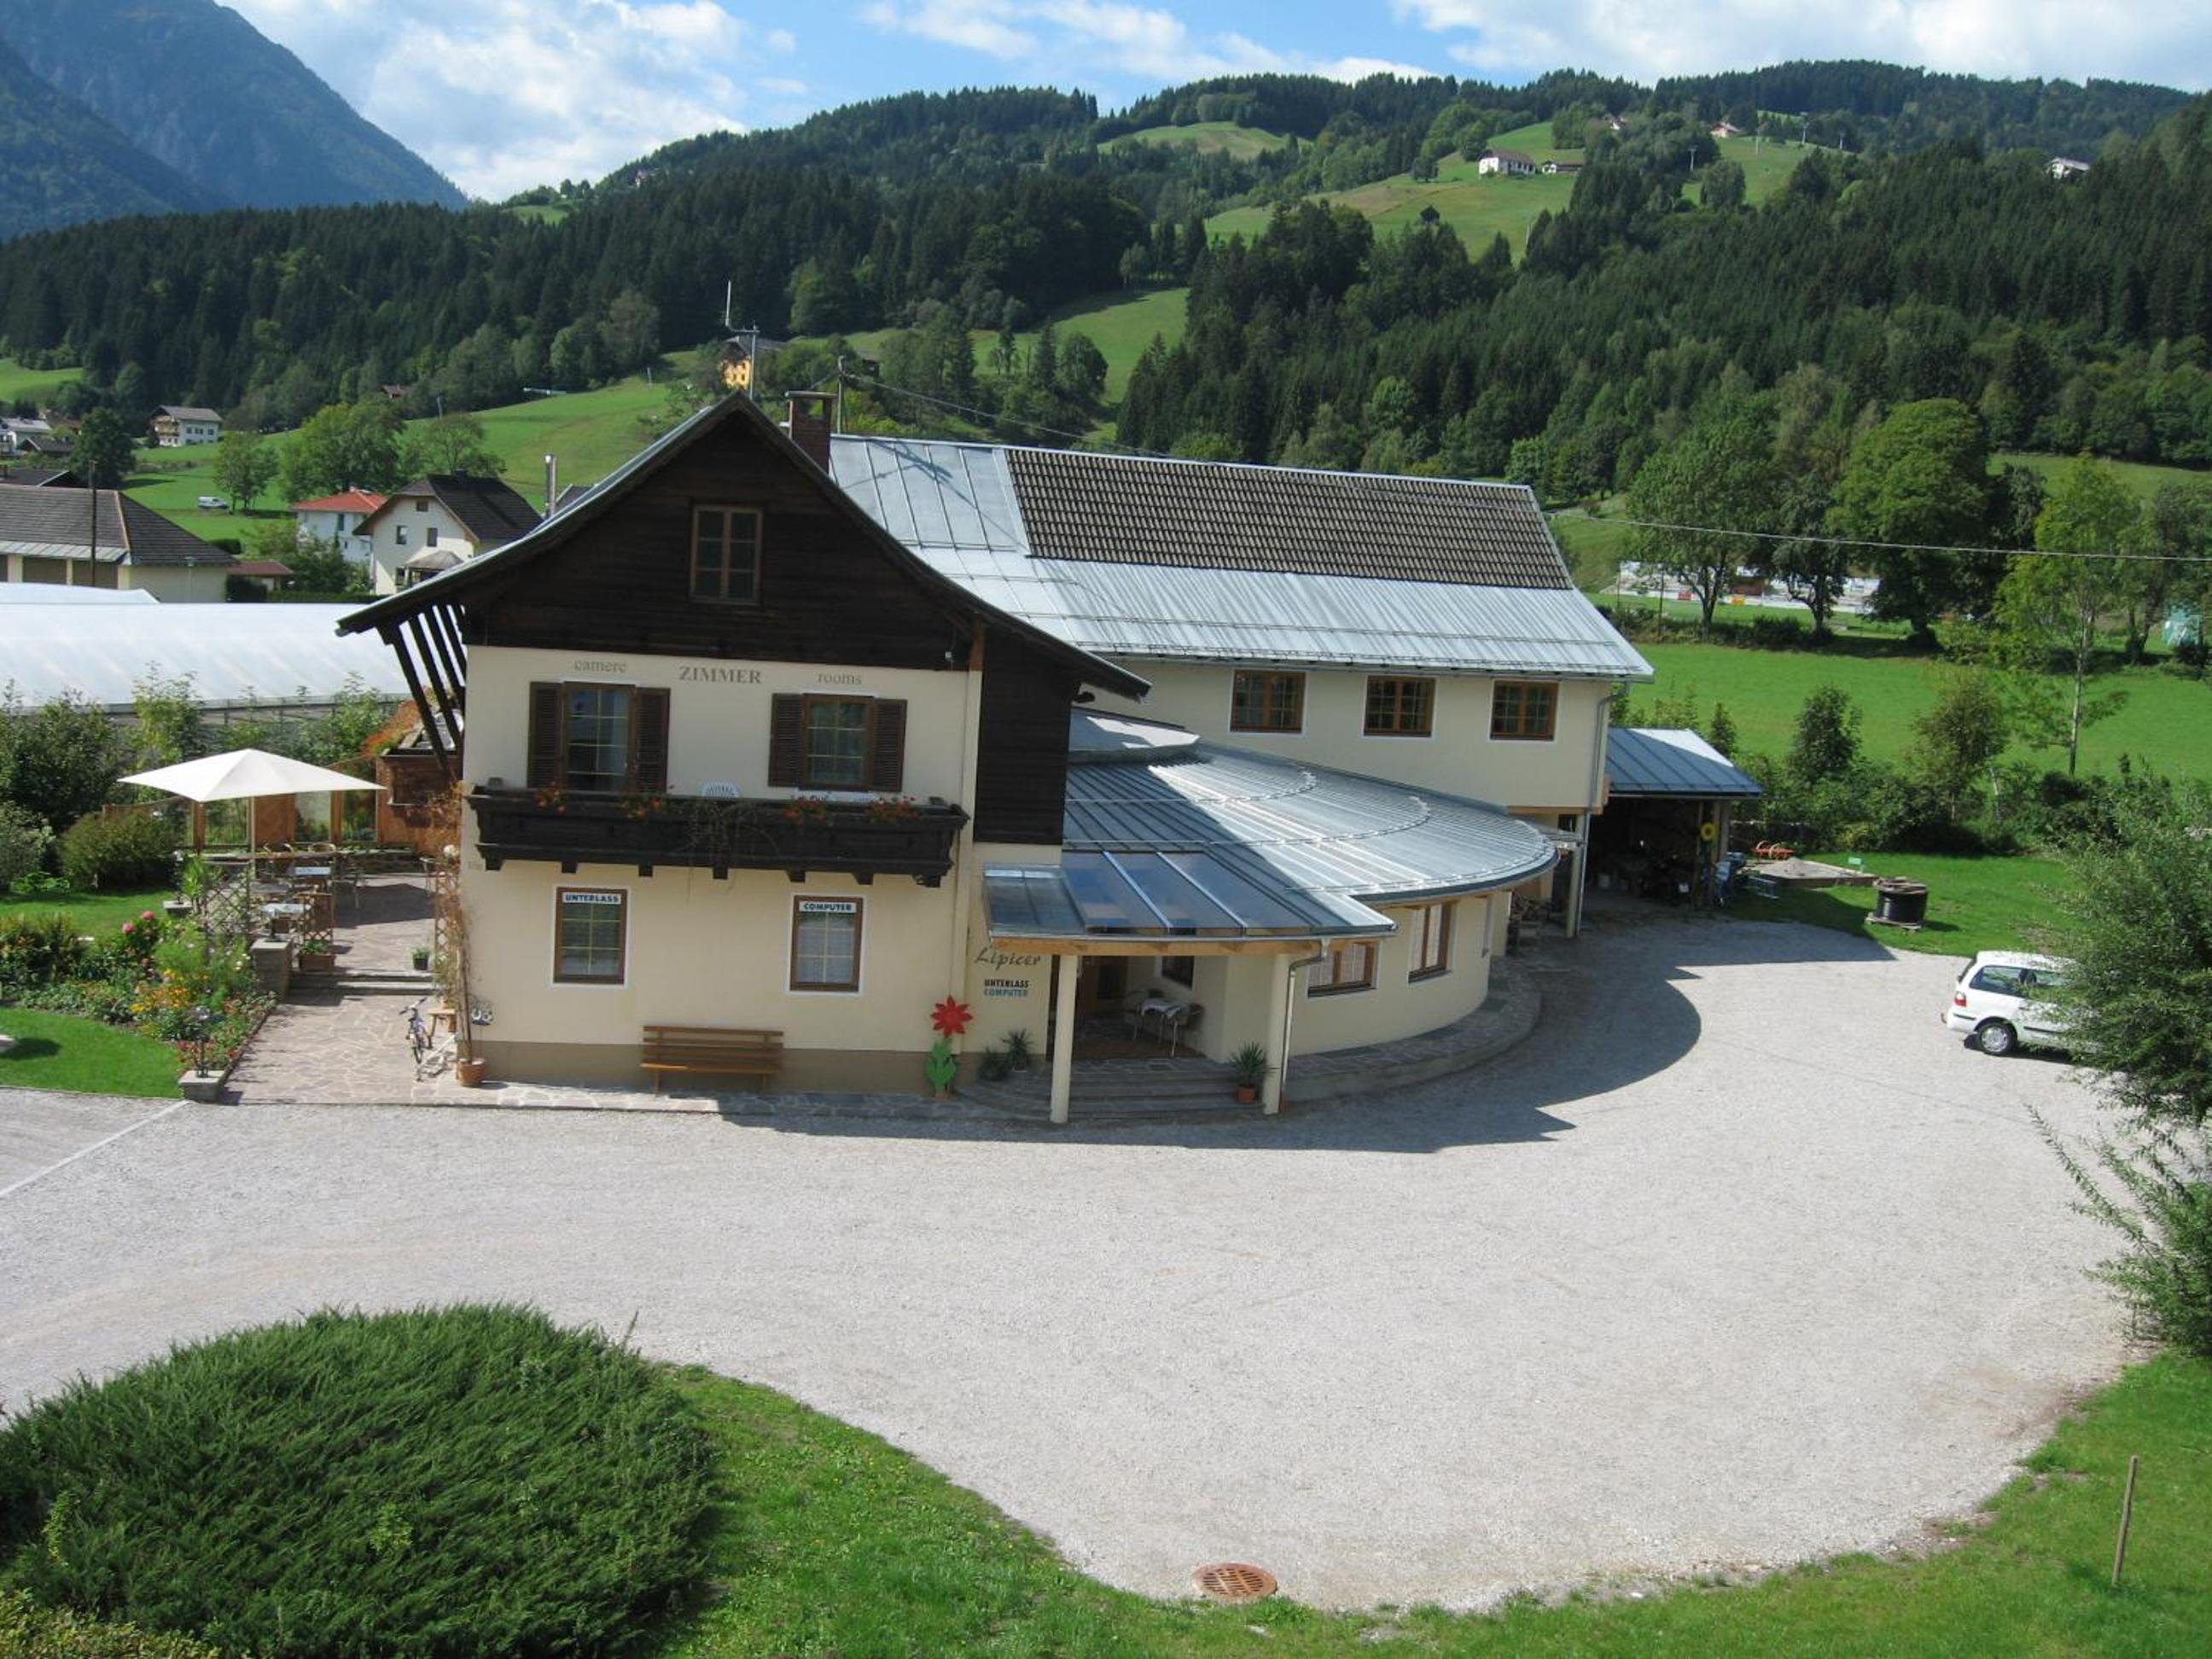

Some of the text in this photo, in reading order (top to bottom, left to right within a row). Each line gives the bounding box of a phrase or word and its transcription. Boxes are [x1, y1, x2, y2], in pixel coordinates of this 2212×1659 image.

[679, 665, 761, 684] ZIMMER
[818, 672, 863, 685] rooms
[564, 893, 619, 903] UNTERLASS
[803, 902, 853, 911] COMPUTER
[984, 978, 1030, 988] UNTERLASS
[984, 988, 1028, 997] COMPUTER
